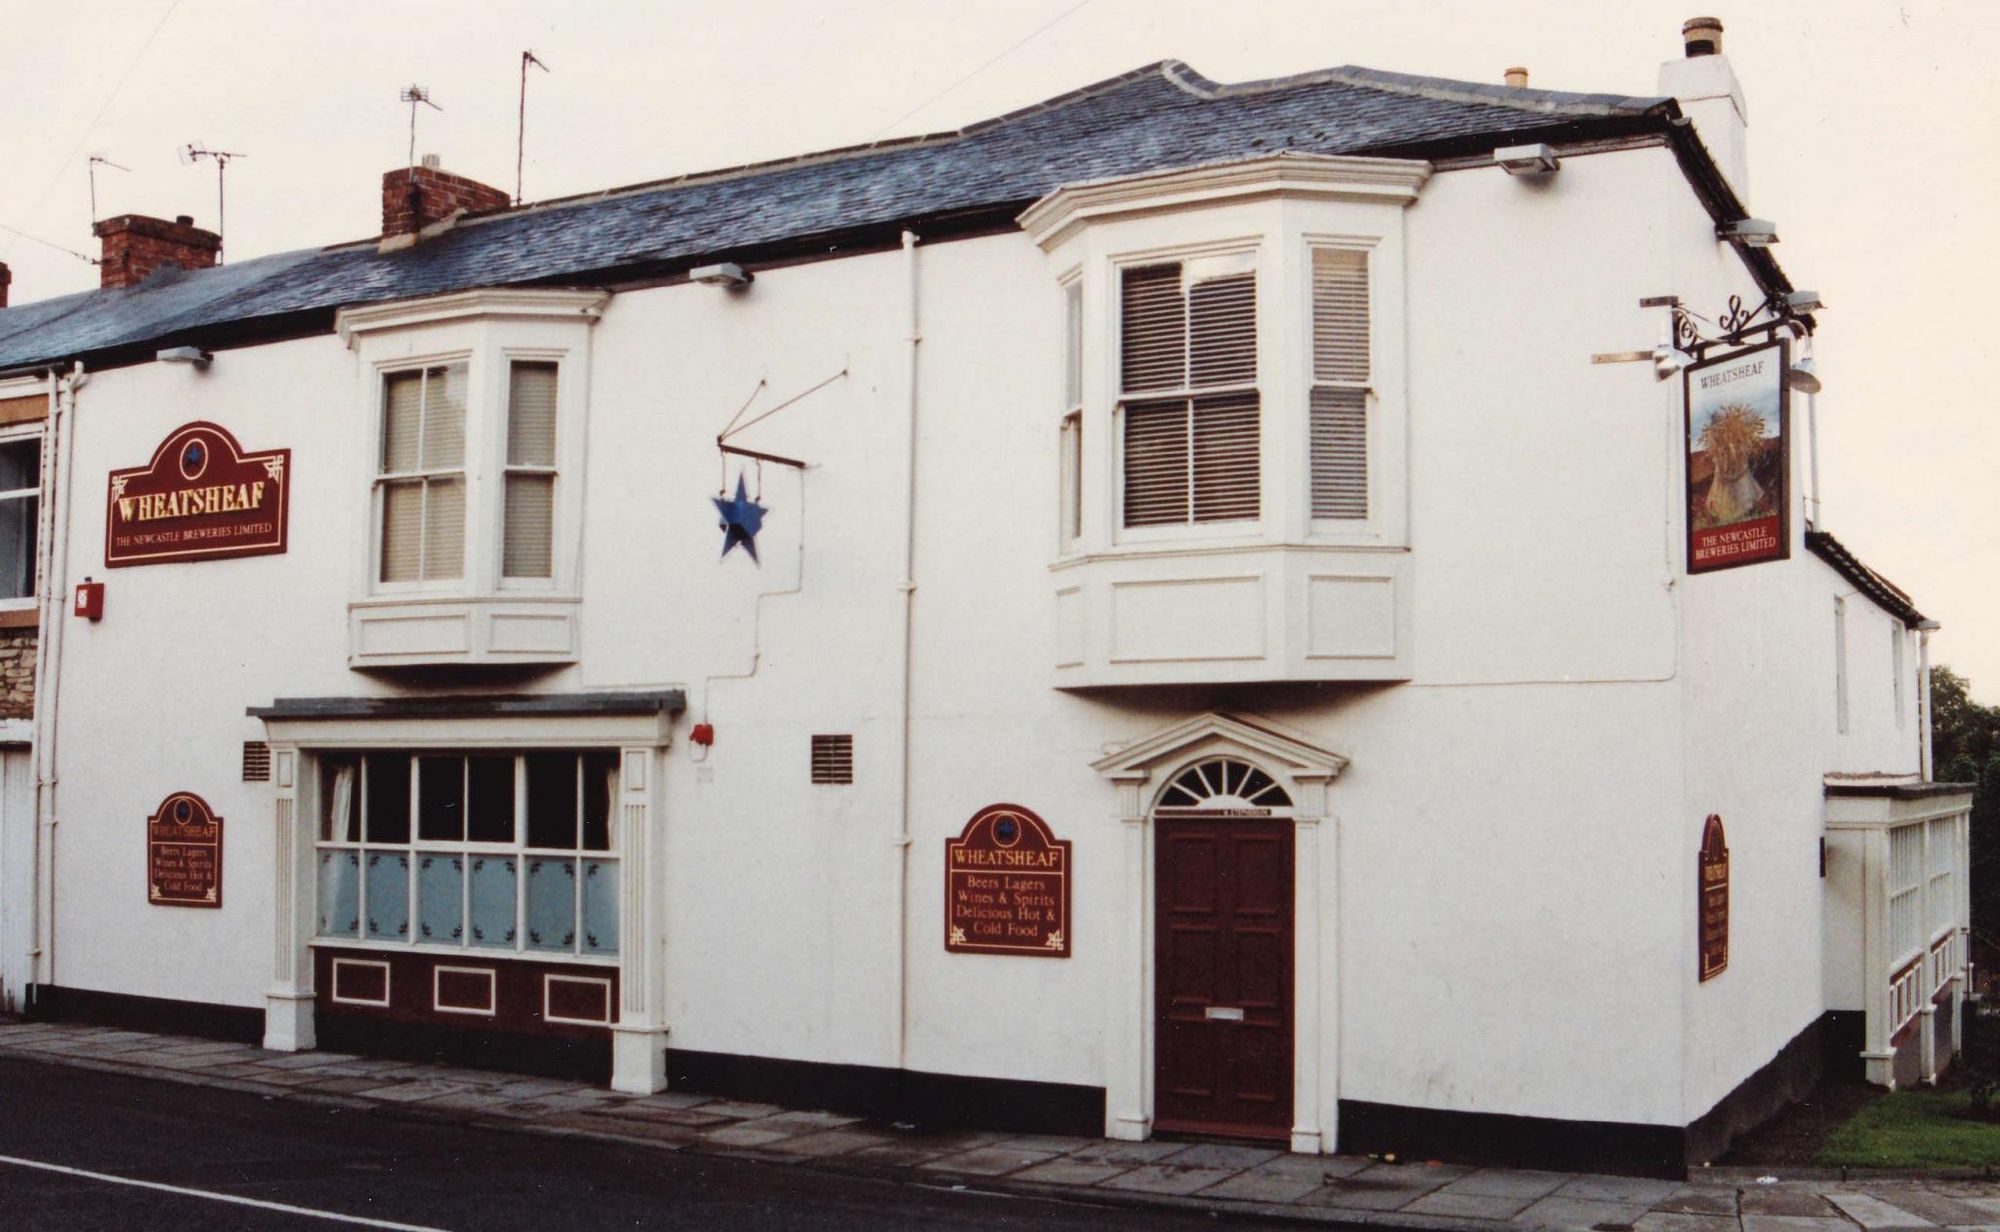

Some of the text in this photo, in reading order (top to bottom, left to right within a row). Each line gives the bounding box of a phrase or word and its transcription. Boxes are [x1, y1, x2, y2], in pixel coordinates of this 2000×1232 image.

[1700, 360, 1765, 389] WHEATSHEAF
[118, 481, 265, 523] WHEATSHEAF
[116, 523, 273, 547] THE NEWCASTLE BREWERIES LIMITED
[1702, 526, 1767, 547] THE NEWCASTLE
[1695, 536, 1776, 560] BREWERIES LIMITED
[954, 849, 1059, 867] WHEATSHEAF
[967, 875, 1046, 892] Beers Lagers
[958, 890, 1055, 907] Wines & Spirits
[956, 905, 1056, 921] Delicious Hot &
[973, 921, 1038, 937] Cold Food
